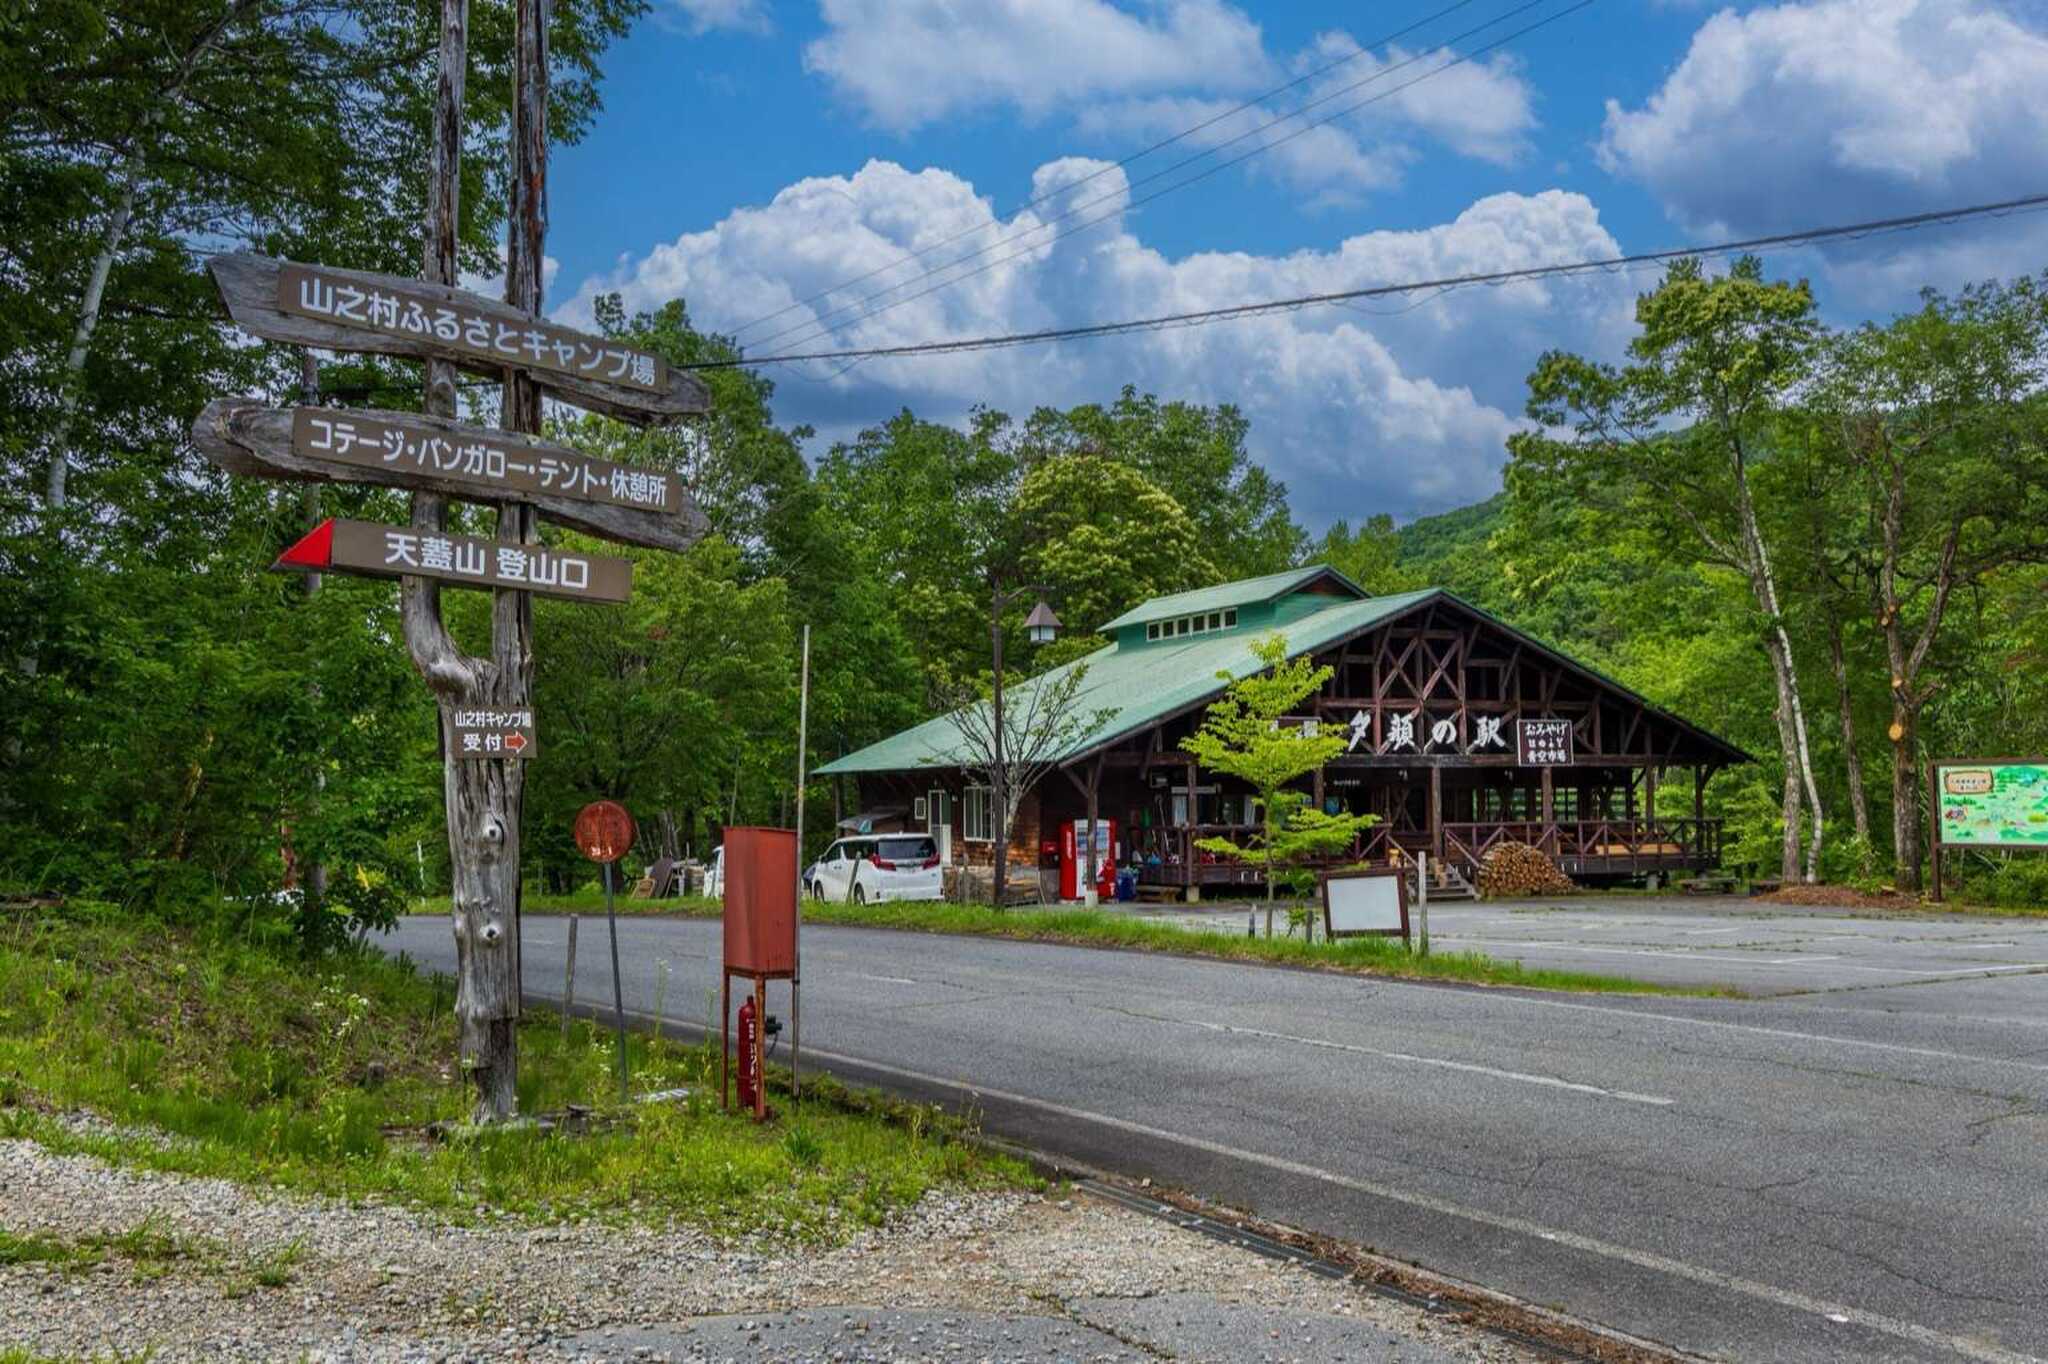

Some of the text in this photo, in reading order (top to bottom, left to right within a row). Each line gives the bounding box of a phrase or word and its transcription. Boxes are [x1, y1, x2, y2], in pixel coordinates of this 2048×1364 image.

[301, 277, 656, 386] 山之村ふるさとキャンプ場
[384, 532, 589, 589] 天蓋山 登山口
[455, 709, 532, 729] 山之村キャンプ場
[463, 733, 502, 752] 受付
